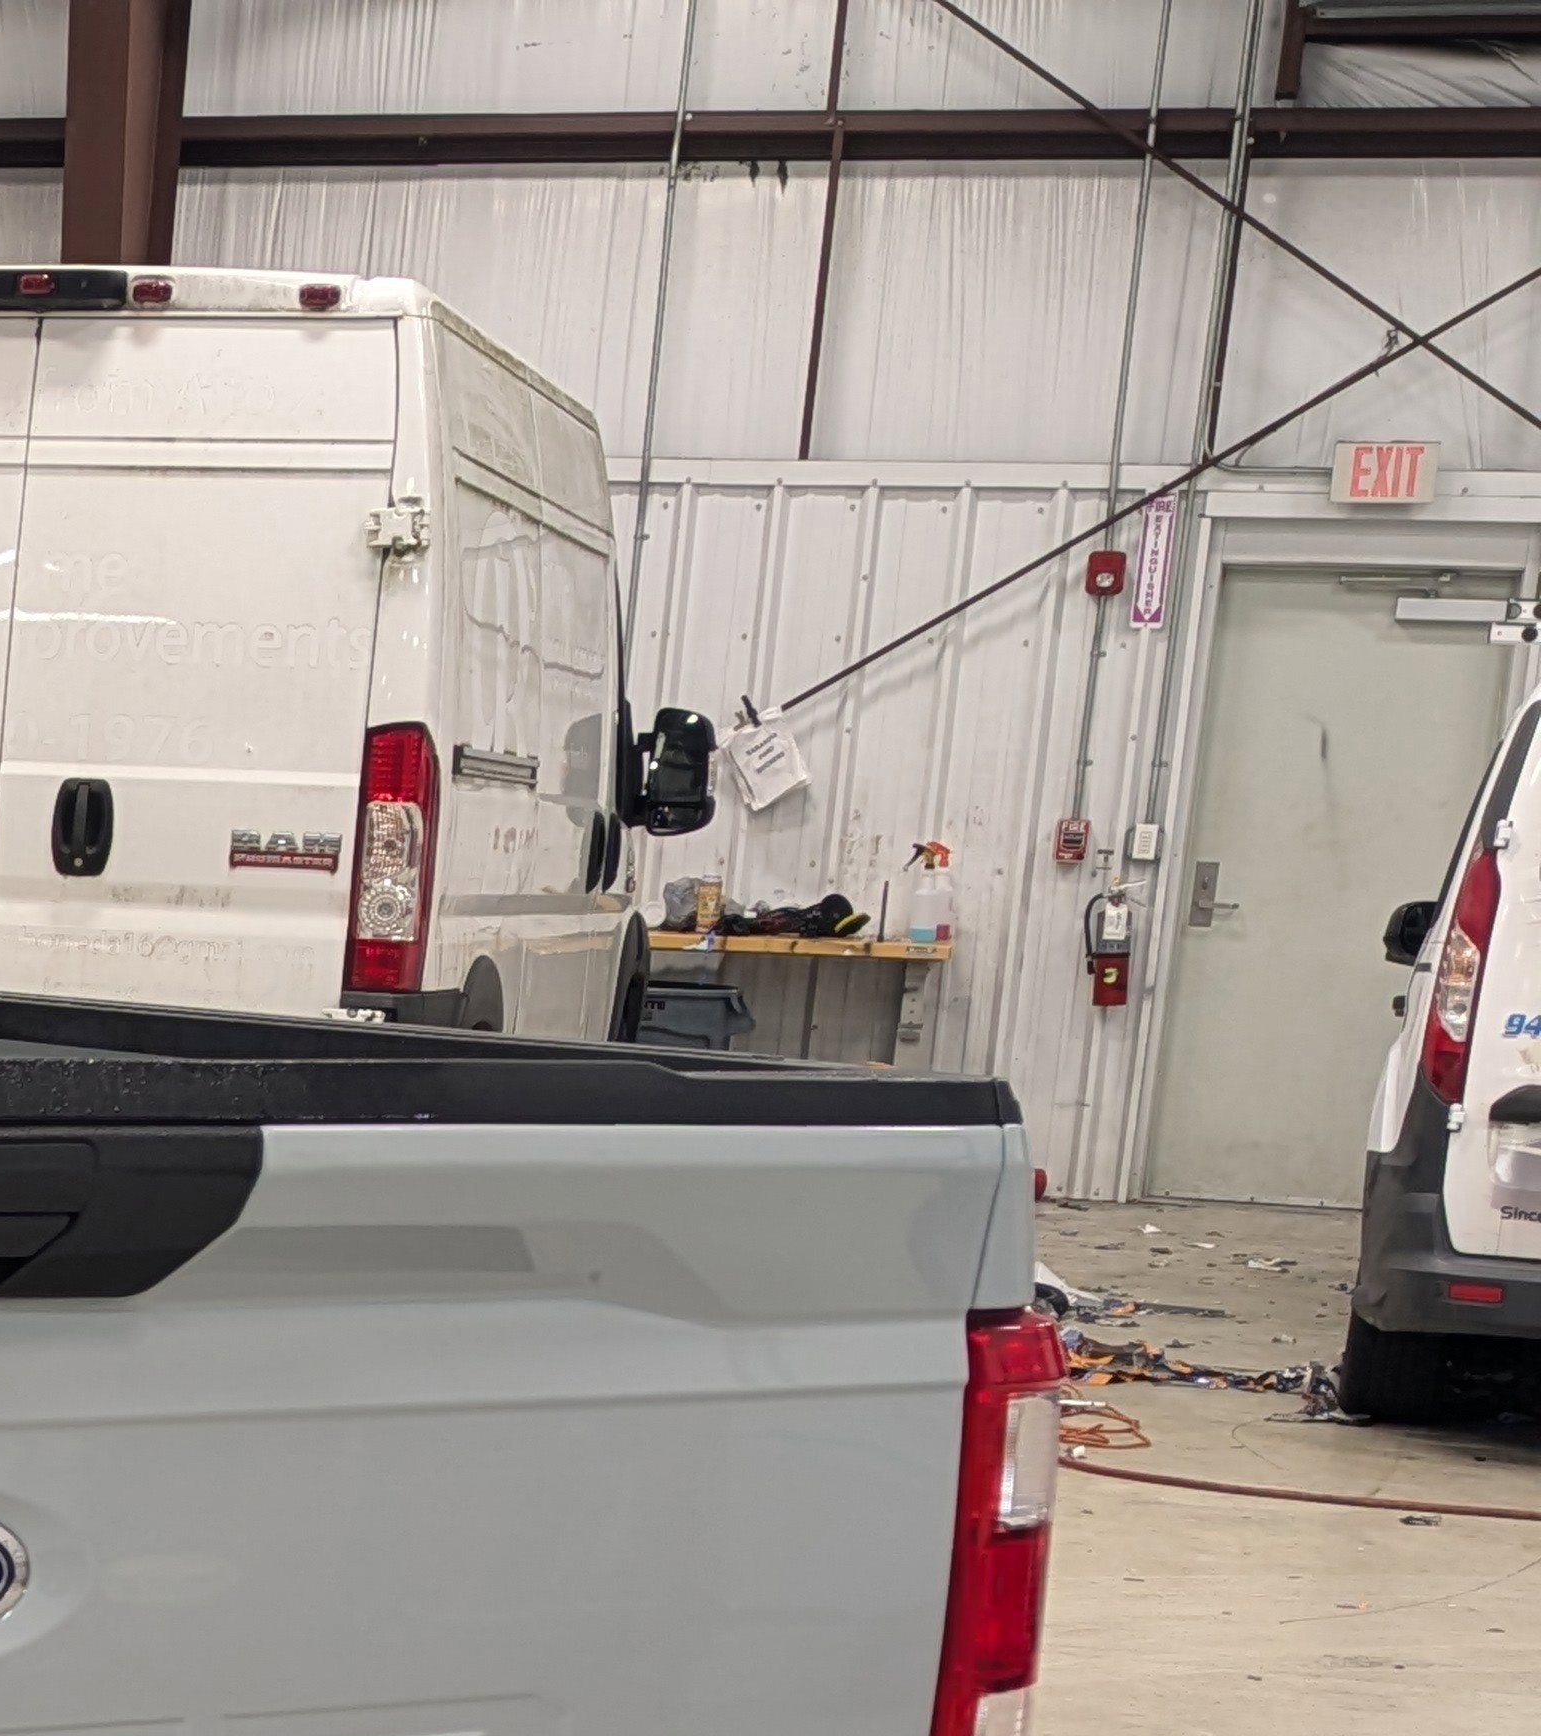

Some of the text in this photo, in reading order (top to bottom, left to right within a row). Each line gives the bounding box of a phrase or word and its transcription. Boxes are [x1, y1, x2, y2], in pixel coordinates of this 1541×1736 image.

[1350, 446, 1425, 498] EXIT
[231, 830, 342, 851] RAM
[232, 852, 334, 868] PROMASTER
